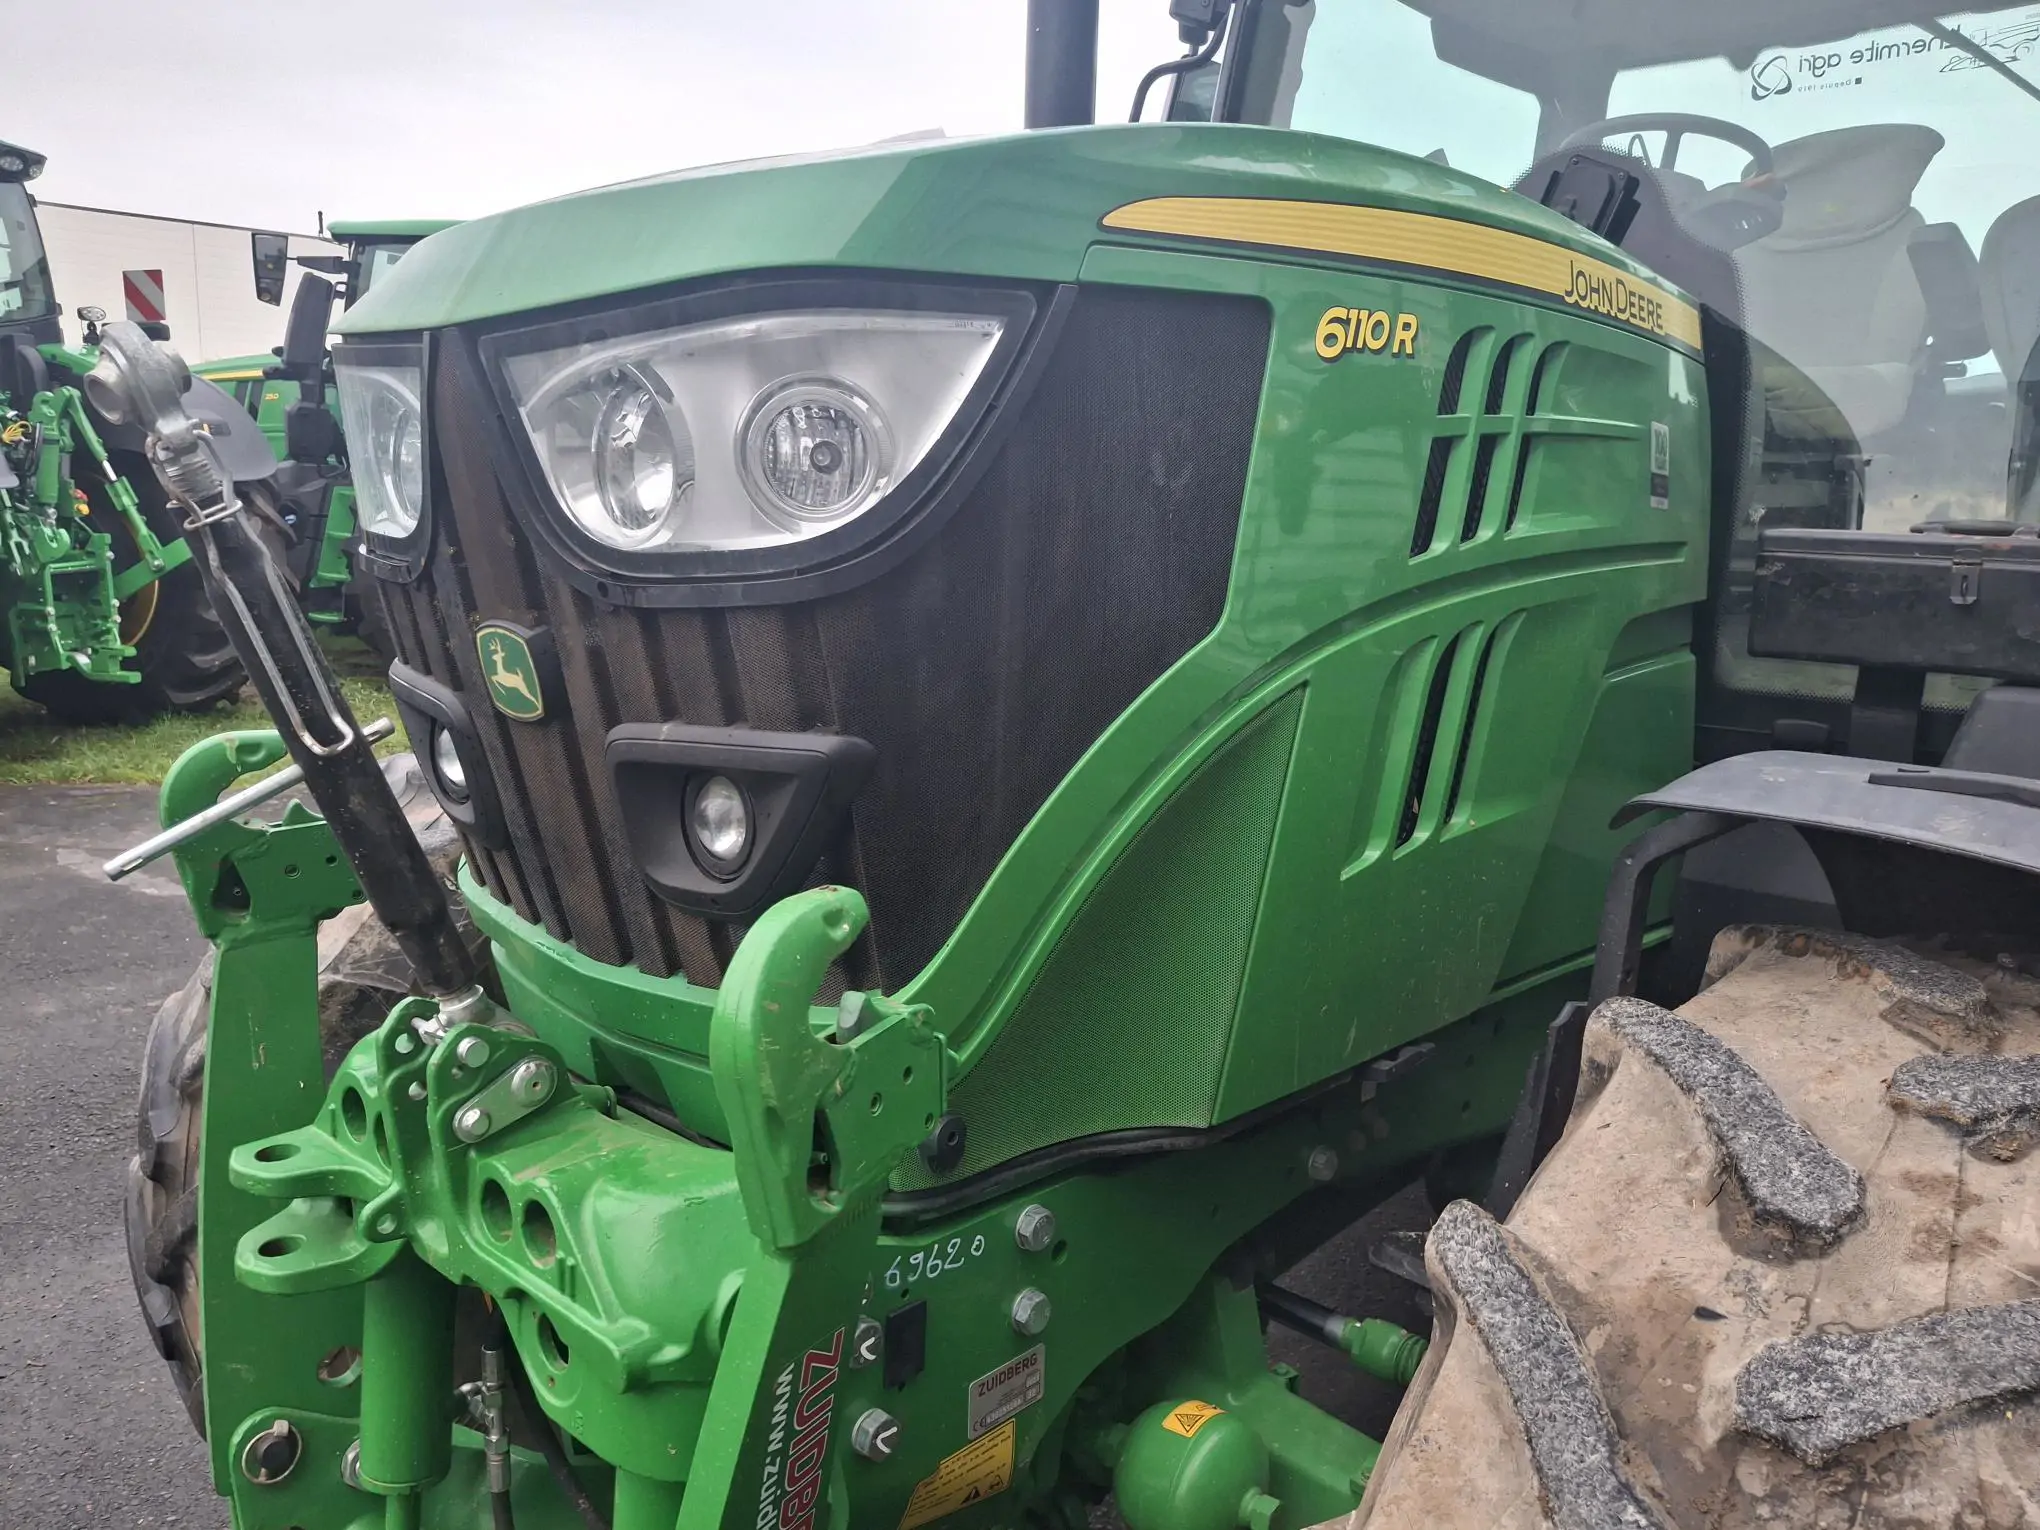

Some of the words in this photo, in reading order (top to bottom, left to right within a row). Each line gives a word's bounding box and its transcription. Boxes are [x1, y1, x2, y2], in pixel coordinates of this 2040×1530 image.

[1564, 259, 1613, 312] JOHN
[1615, 277, 1664, 331] DEERE
[978, 1353, 1038, 1398] ZUIDBERG
[779, 1326, 845, 1530] ZUIDB
